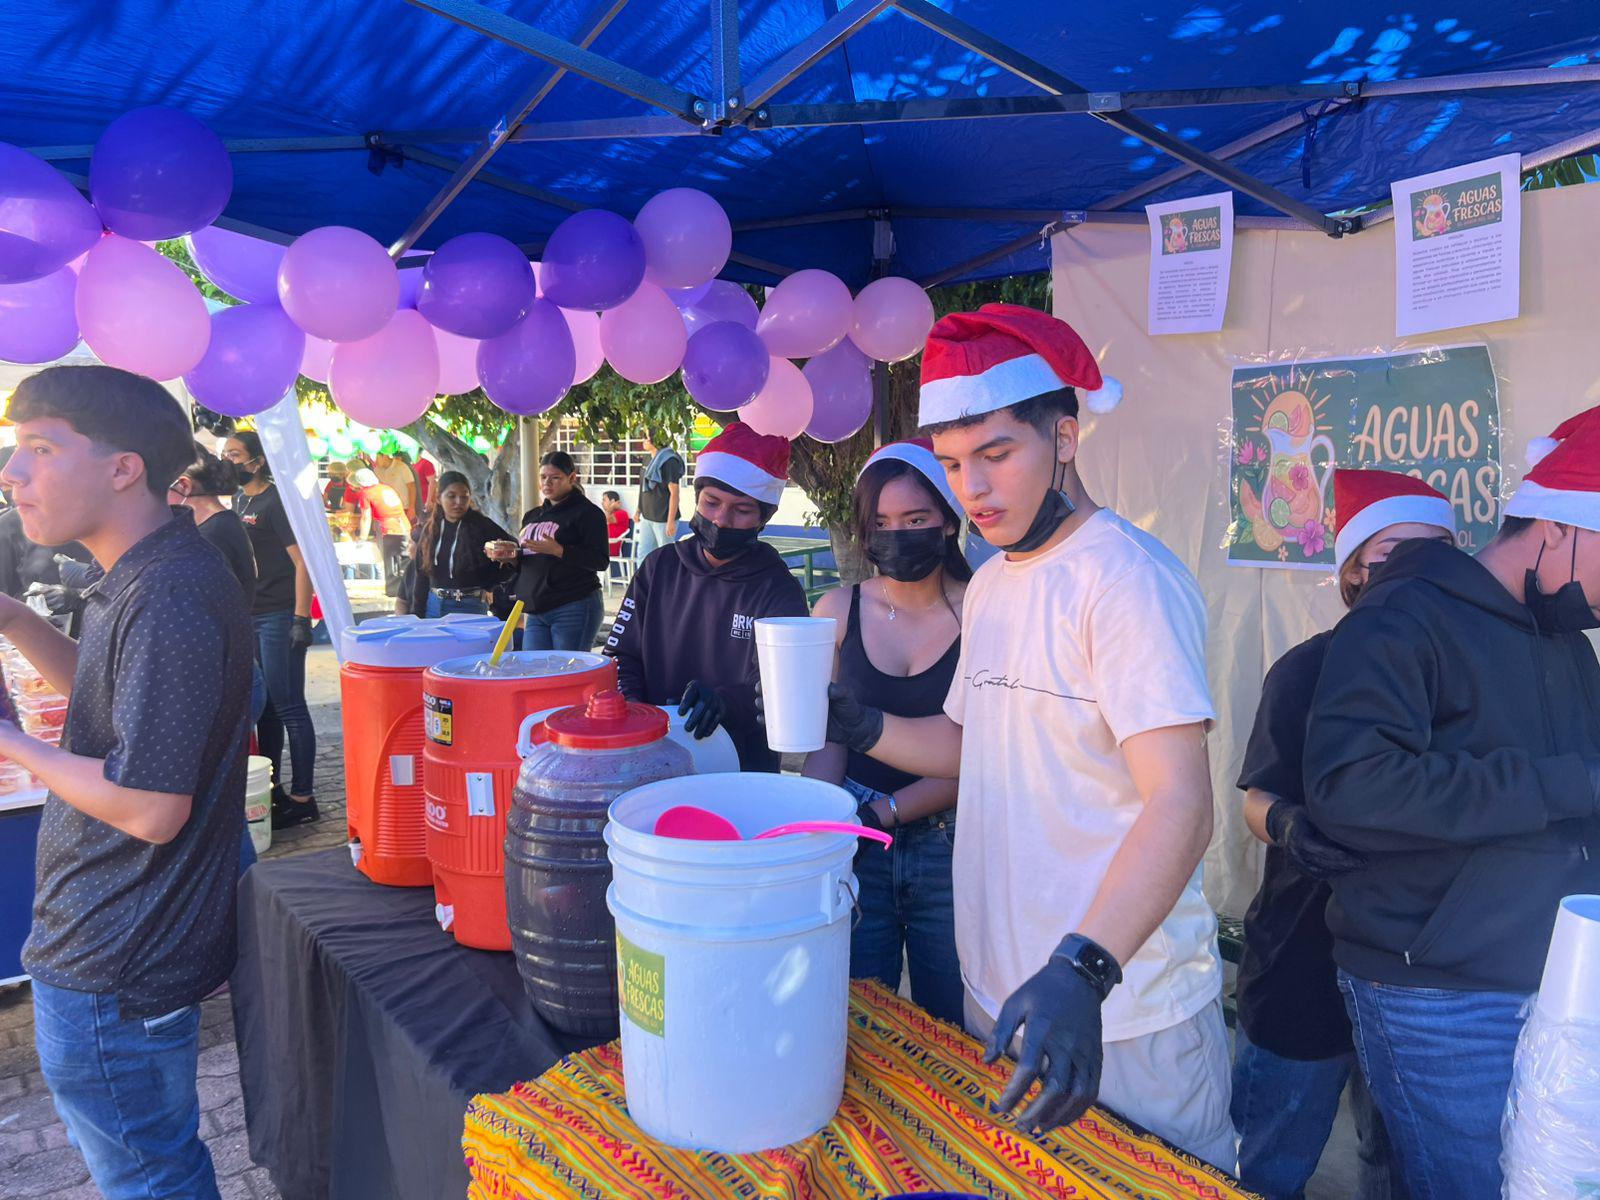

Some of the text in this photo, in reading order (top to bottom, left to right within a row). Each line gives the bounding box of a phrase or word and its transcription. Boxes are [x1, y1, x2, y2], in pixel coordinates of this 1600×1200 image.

[1457, 184, 1496, 206] AGUAS
[1452, 199, 1501, 221] FRESCAS
[1192, 216, 1217, 232] AGUAS
[1189, 229, 1220, 244] FRESCAS
[1354, 400, 1479, 461] AGUAS
[604, 597, 636, 653] BROO
[733, 613, 753, 630] BRK
[628, 959, 659, 993] AGUAS
[626, 980, 664, 1020] FRESCAS
